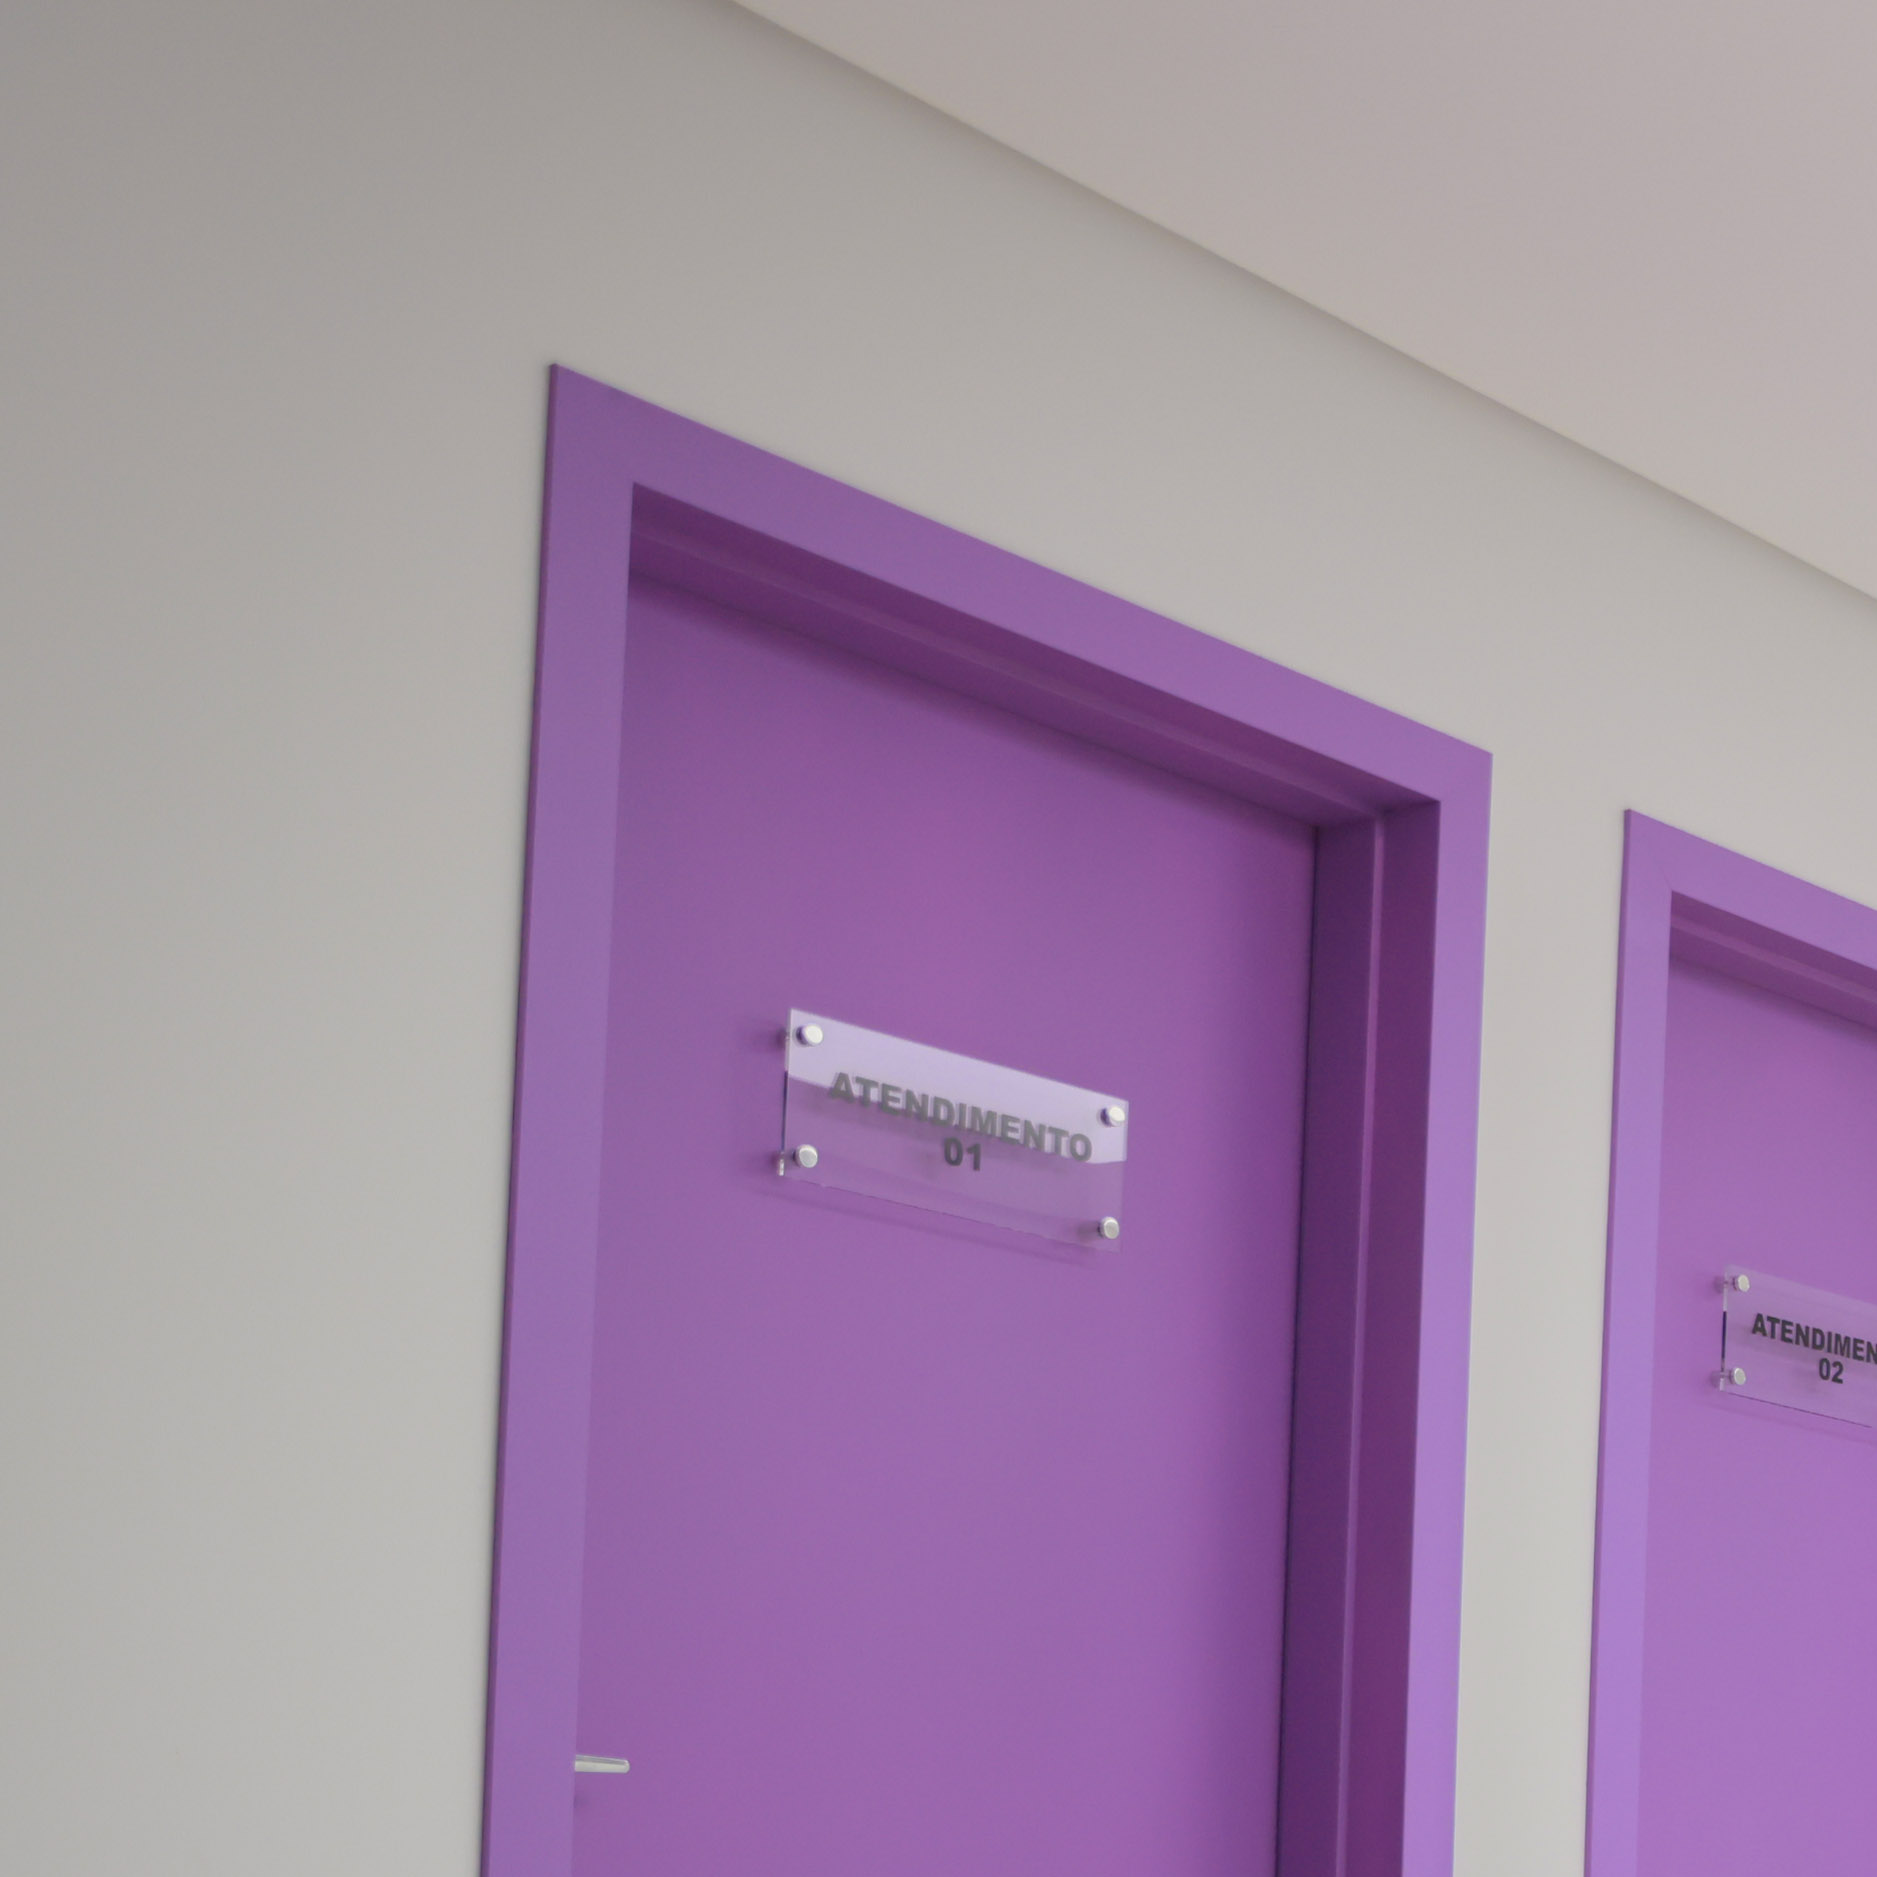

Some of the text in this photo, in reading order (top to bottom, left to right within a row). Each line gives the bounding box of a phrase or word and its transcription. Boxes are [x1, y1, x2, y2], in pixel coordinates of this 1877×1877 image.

[829, 1071, 1093, 1163] ATENDIMENTO
[944, 1137, 982, 1171] 01
[1818, 1357, 1844, 1384] 02
